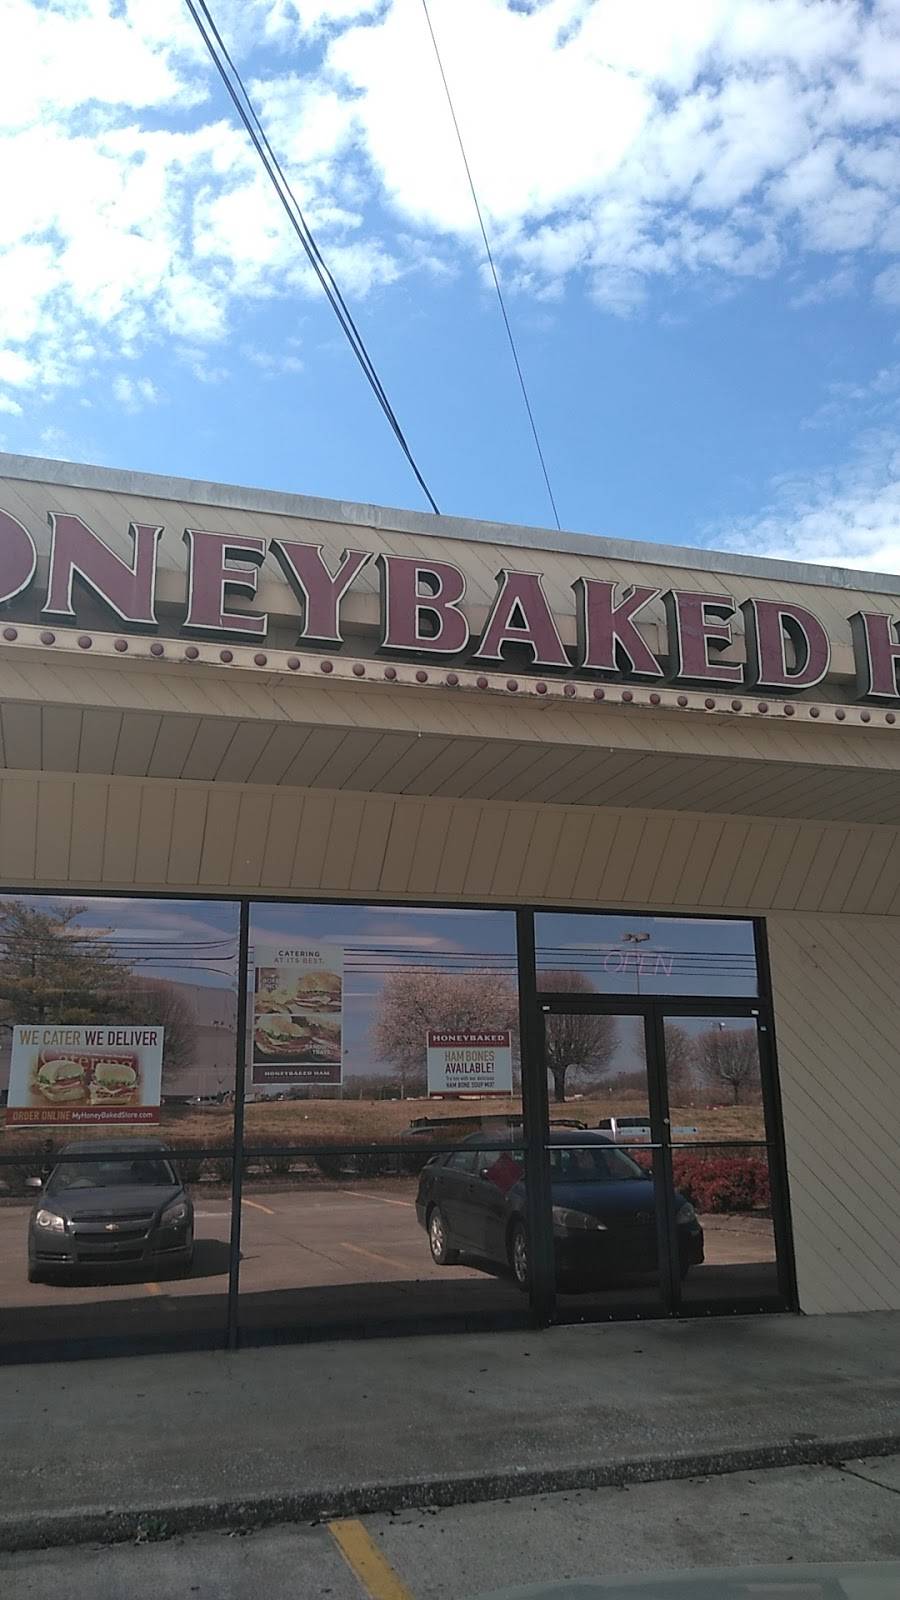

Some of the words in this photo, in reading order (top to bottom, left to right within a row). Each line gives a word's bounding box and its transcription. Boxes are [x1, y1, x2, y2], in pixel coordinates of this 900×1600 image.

[604, 951, 673, 976] OPEN
[20, 1030, 39, 1045] WE
[43, 1030, 81, 1046] CATER
[85, 1030, 105, 1046] WE
[108, 1031, 157, 1046] DELIVER
[445, 1050, 465, 1062] HAM
[466, 1050, 495, 1062] BONES
[445, 1062, 495, 1074] AVAILABLE!
[12, 1111, 40, 1121] ORDER
[42, 1110, 71, 1120] ONLINE
[72, 1111, 153, 1120] MyHoneyBakedStore.com
